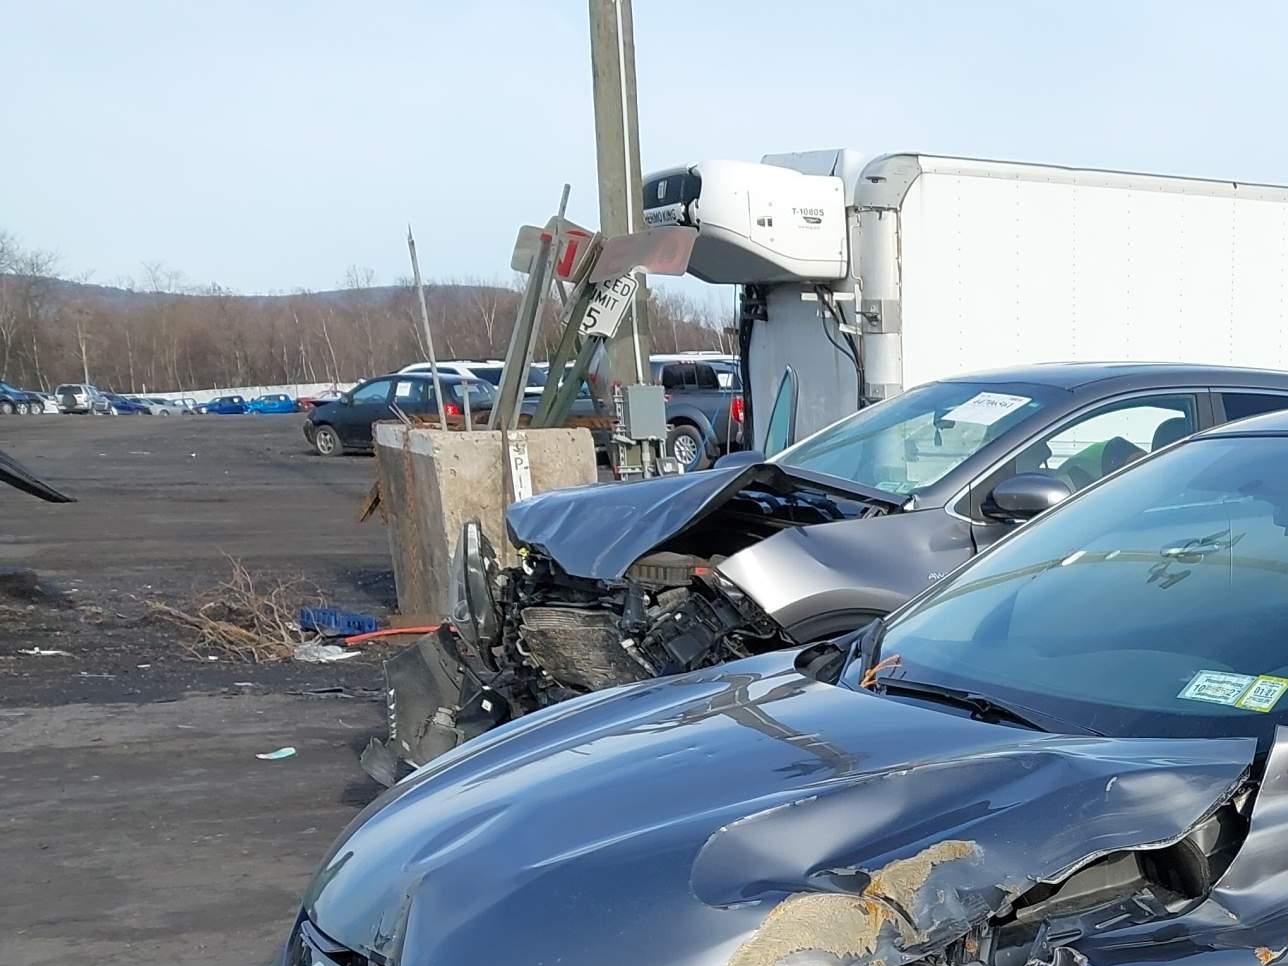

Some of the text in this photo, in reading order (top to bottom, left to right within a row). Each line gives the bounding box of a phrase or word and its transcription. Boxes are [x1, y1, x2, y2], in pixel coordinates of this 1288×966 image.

[791, 207, 825, 217] T-1080S
[603, 278, 631, 297] EED
[590, 287, 619, 311] IMIT
